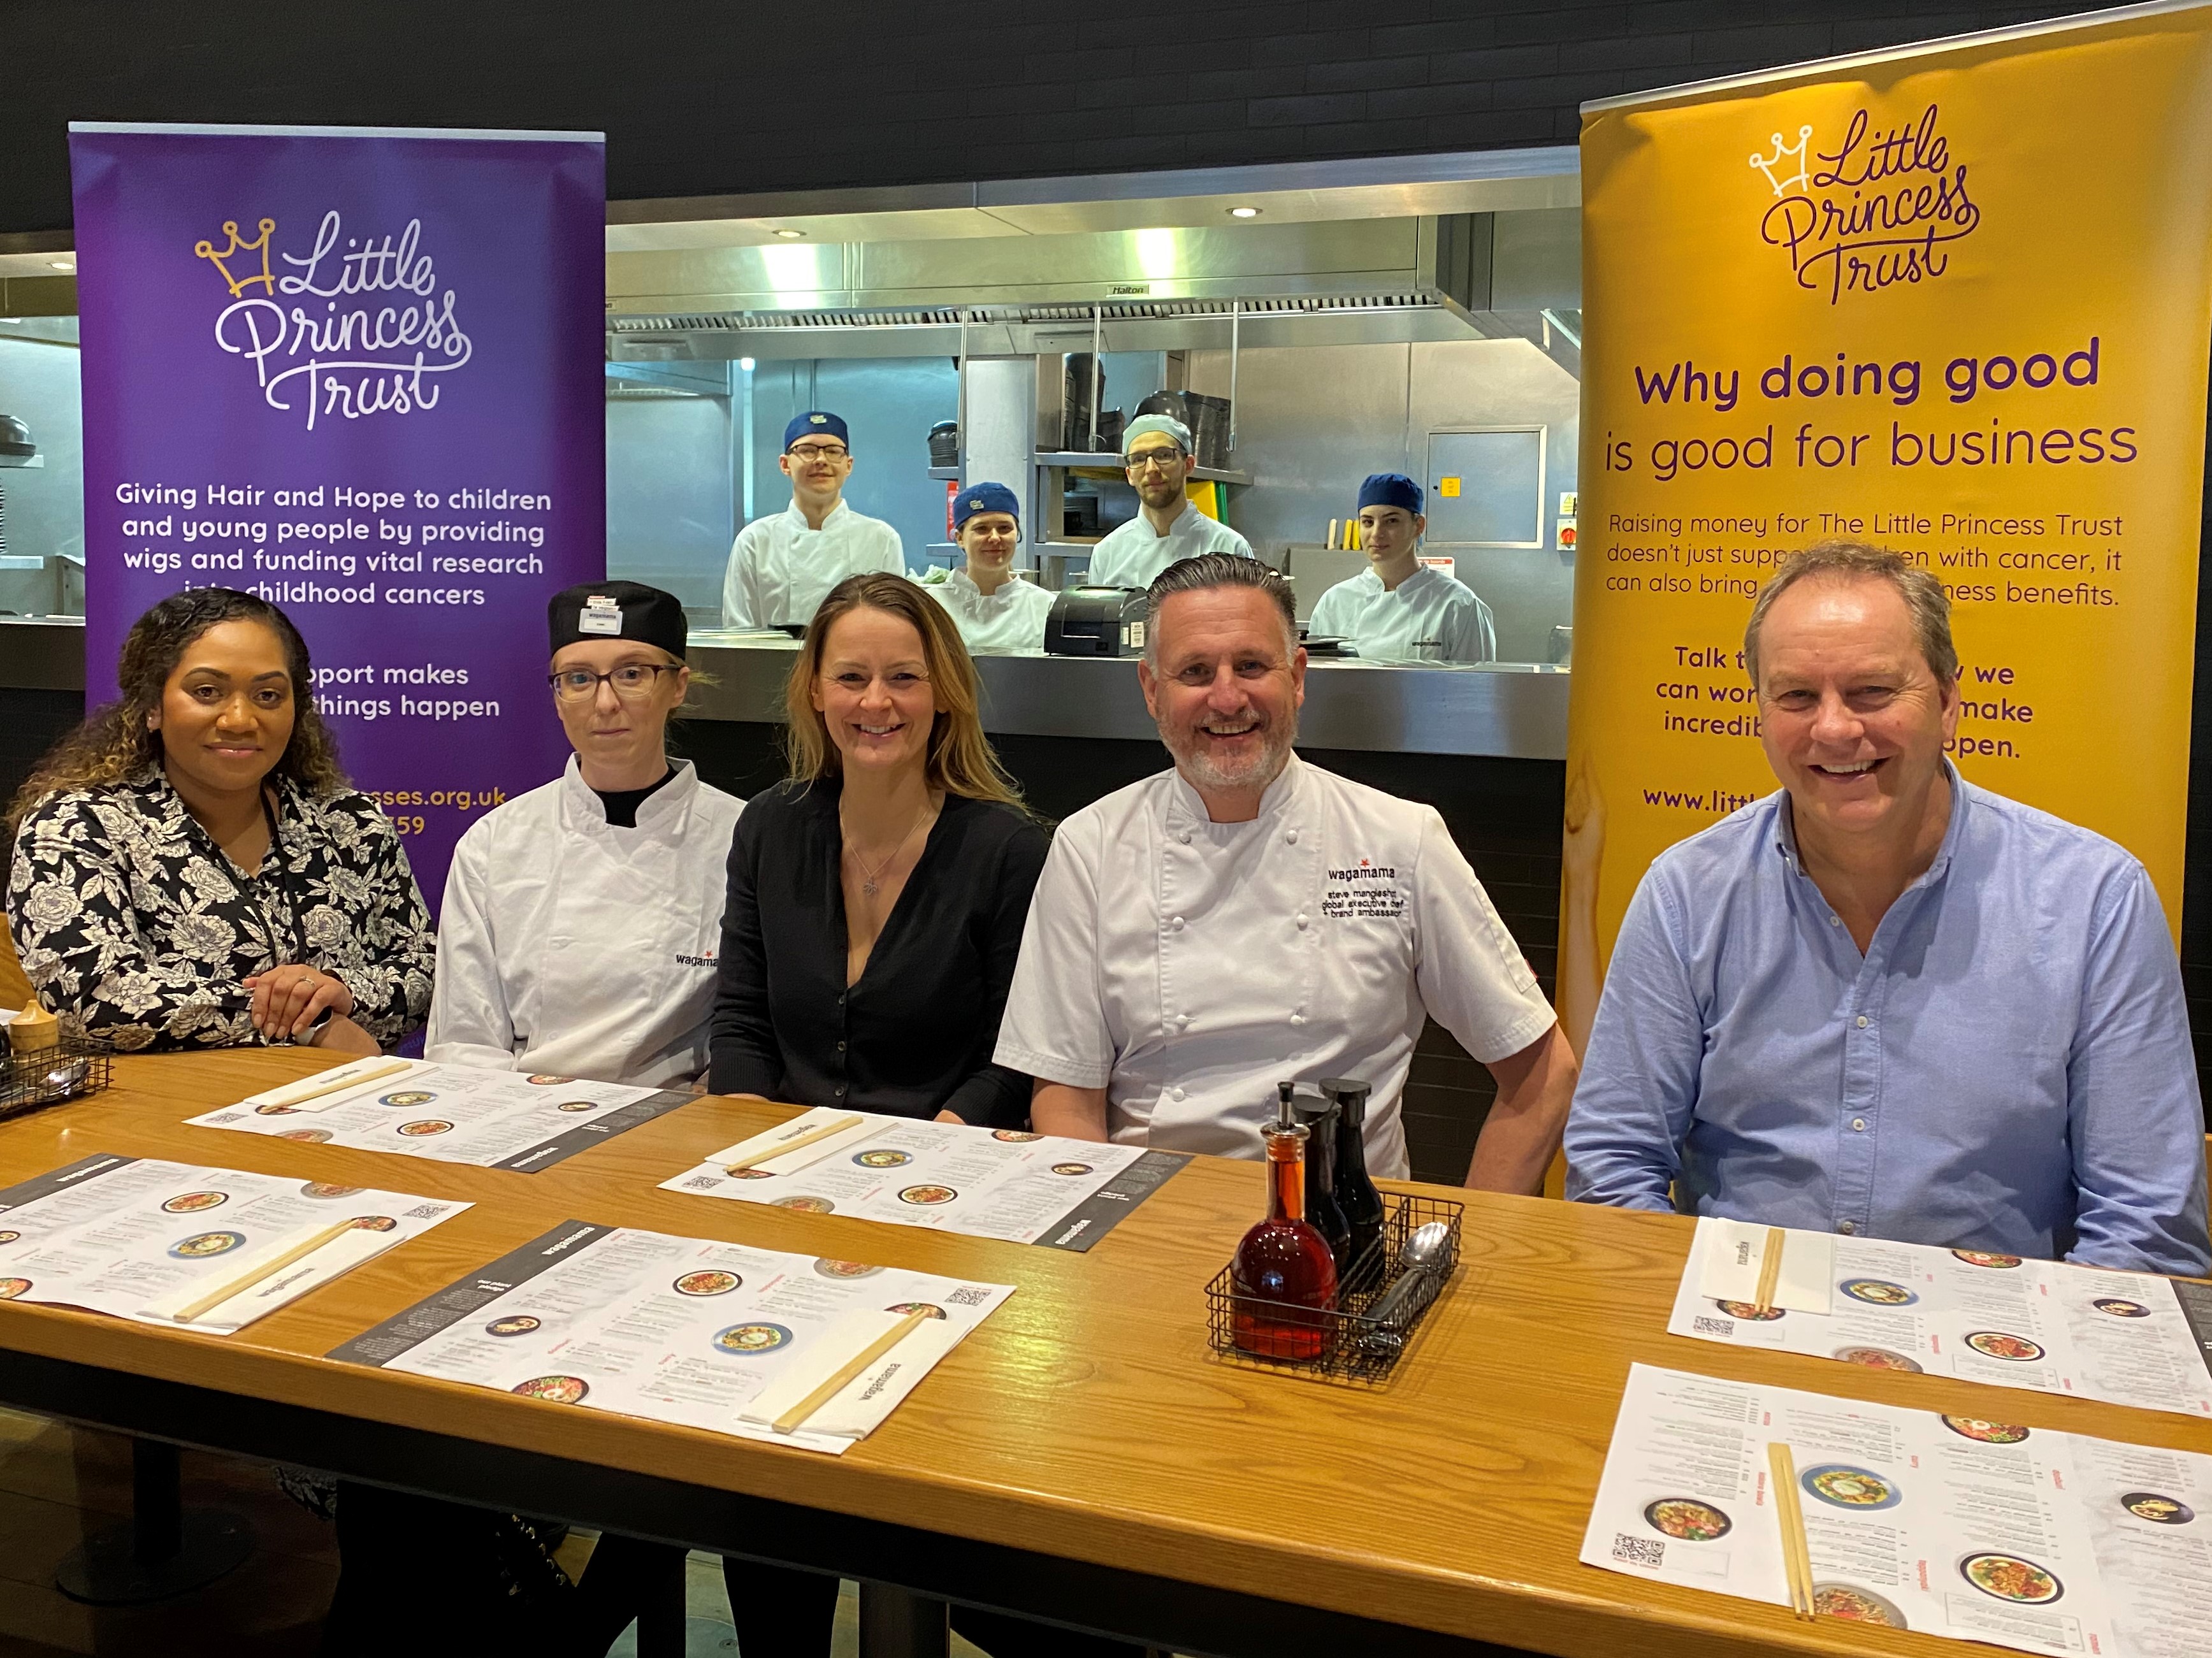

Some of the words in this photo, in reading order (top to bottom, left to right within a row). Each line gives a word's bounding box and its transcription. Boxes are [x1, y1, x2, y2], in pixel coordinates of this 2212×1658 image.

[1813, 103, 1949, 187] Little
[1761, 164, 1980, 271] Princess
[279, 210, 435, 298] Little
[1798, 225, 1948, 306] Trust
[215, 289, 473, 388] Princess
[266, 350, 440, 431] Trust
[1635, 361, 1739, 412] Why
[1761, 353, 1920, 405] doing
[1946, 337, 2099, 403] good
[1607, 431, 1632, 471] is
[1652, 425, 1772, 481] good
[1795, 424, 1870, 467] for
[1892, 418, 2137, 466] business
[117, 483, 196, 509] Giving
[208, 485, 265, 505] Hair
[274, 486, 323, 506] and
[335, 487, 405, 512] Hope
[414, 490, 439, 508] to
[449, 488, 551, 510] children
[123, 515, 171, 536] and
[183, 522, 266, 543] young
[278, 519, 369, 544] people
[380, 519, 411, 545] by
[423, 521, 544, 547] providing
[1610, 514, 1681, 537] Raising
[1691, 519, 1766, 538] money
[1777, 513, 1809, 533] for
[1819, 513, 1863, 533] The
[1875, 513, 1931, 533] Little
[1942, 514, 2044, 535] Princess
[2056, 515, 2122, 536] Trust
[124, 548, 181, 573] wigs
[192, 549, 242, 569] and
[253, 549, 356, 576] funding
[366, 551, 421, 572] vital
[433, 553, 542, 573] research
[1686, 546, 1723, 567] just
[1939, 547, 1988, 567] with
[1999, 553, 2094, 573] cancer,
[2107, 549, 2122, 570] it
[386, 589, 484, 604] cancers
[1607, 577, 1640, 590] can
[1649, 573, 1691, 592] also
[1700, 573, 1757, 599] bring
[2007, 581, 2118, 605] benefits.
[384, 663, 468, 684] makes
[1675, 647, 1726, 668] Talk
[1975, 667, 2014, 684] we
[401, 695, 499, 720] happen
[1656, 683, 1698, 700] can
[1960, 697, 2034, 723] make
[1329, 867, 1395, 881] wagamama
[542, 1226, 596, 1255] wagamama
